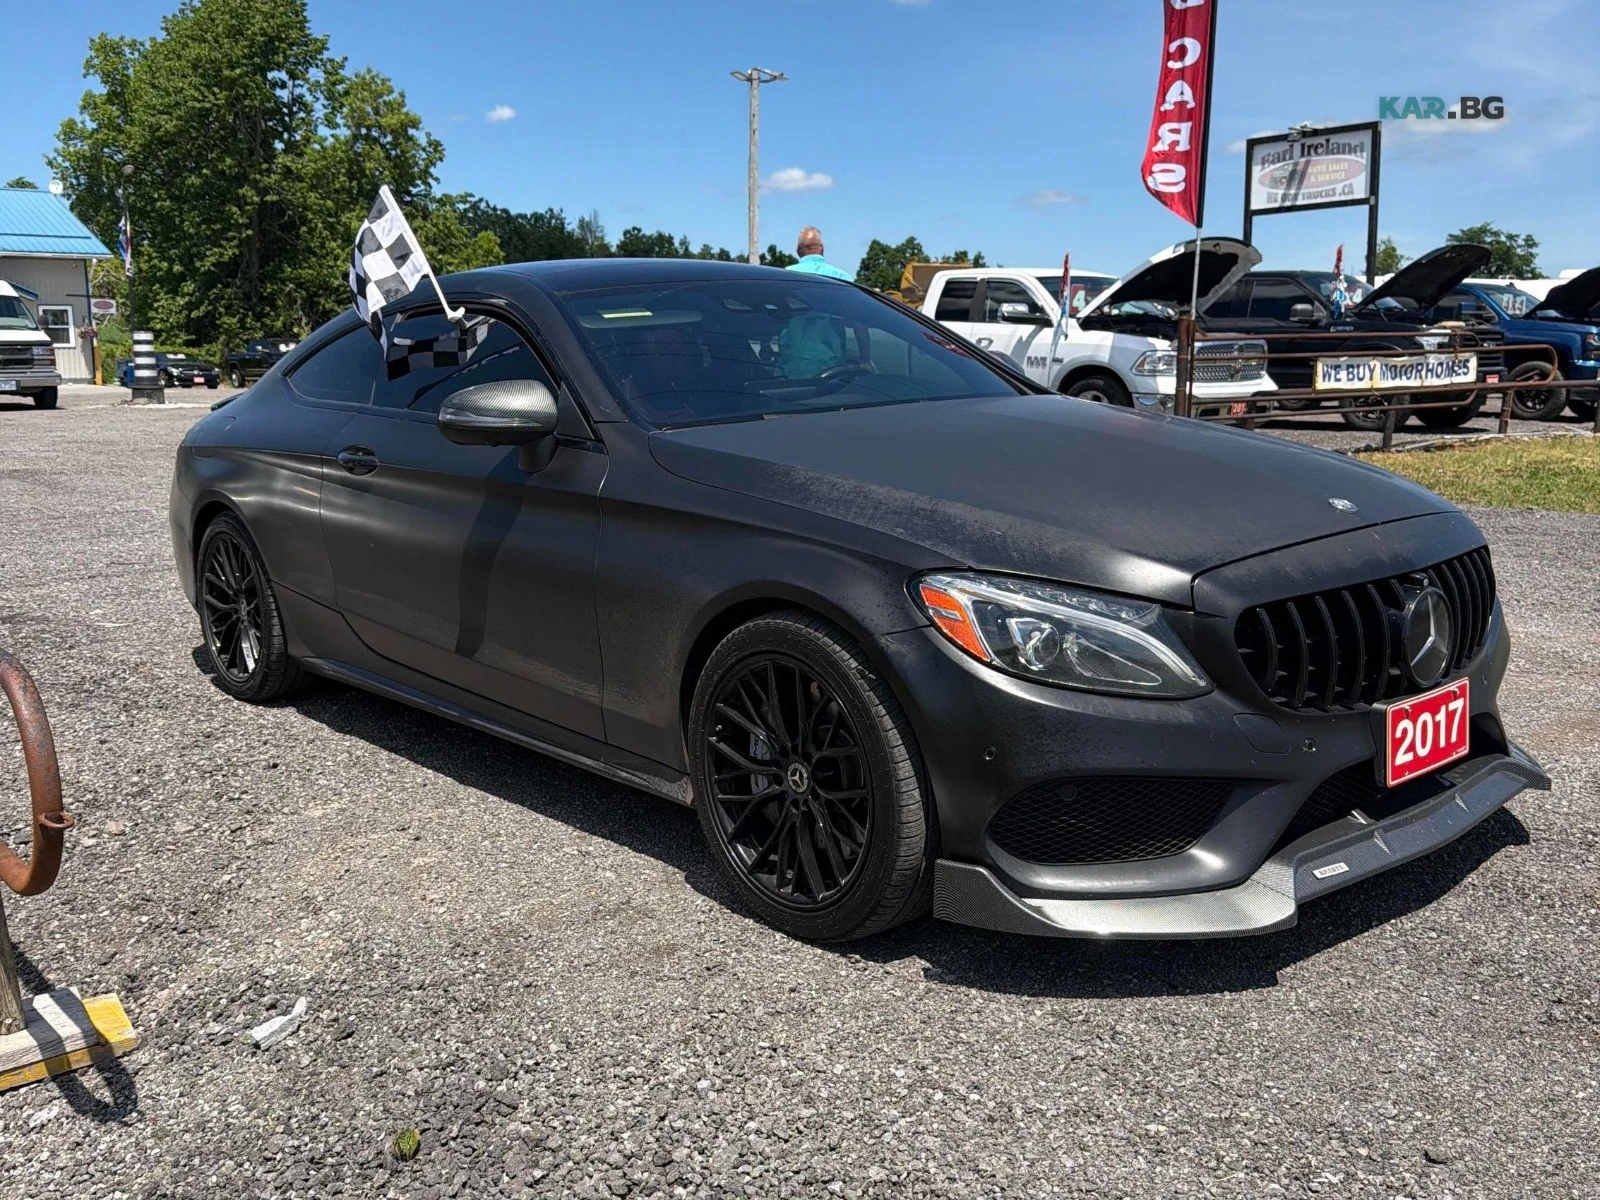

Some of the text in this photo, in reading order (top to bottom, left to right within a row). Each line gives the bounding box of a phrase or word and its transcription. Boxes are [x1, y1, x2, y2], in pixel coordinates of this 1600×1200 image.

[1300, 138, 1365, 158] Ireland
[1308, 162, 1348, 173] AUTO SALES
[1302, 188, 1336, 200] TRUCKS
[1322, 364, 1342, 383] WE
[1346, 362, 1376, 382] BUY
[1394, 698, 1464, 766] 2017
